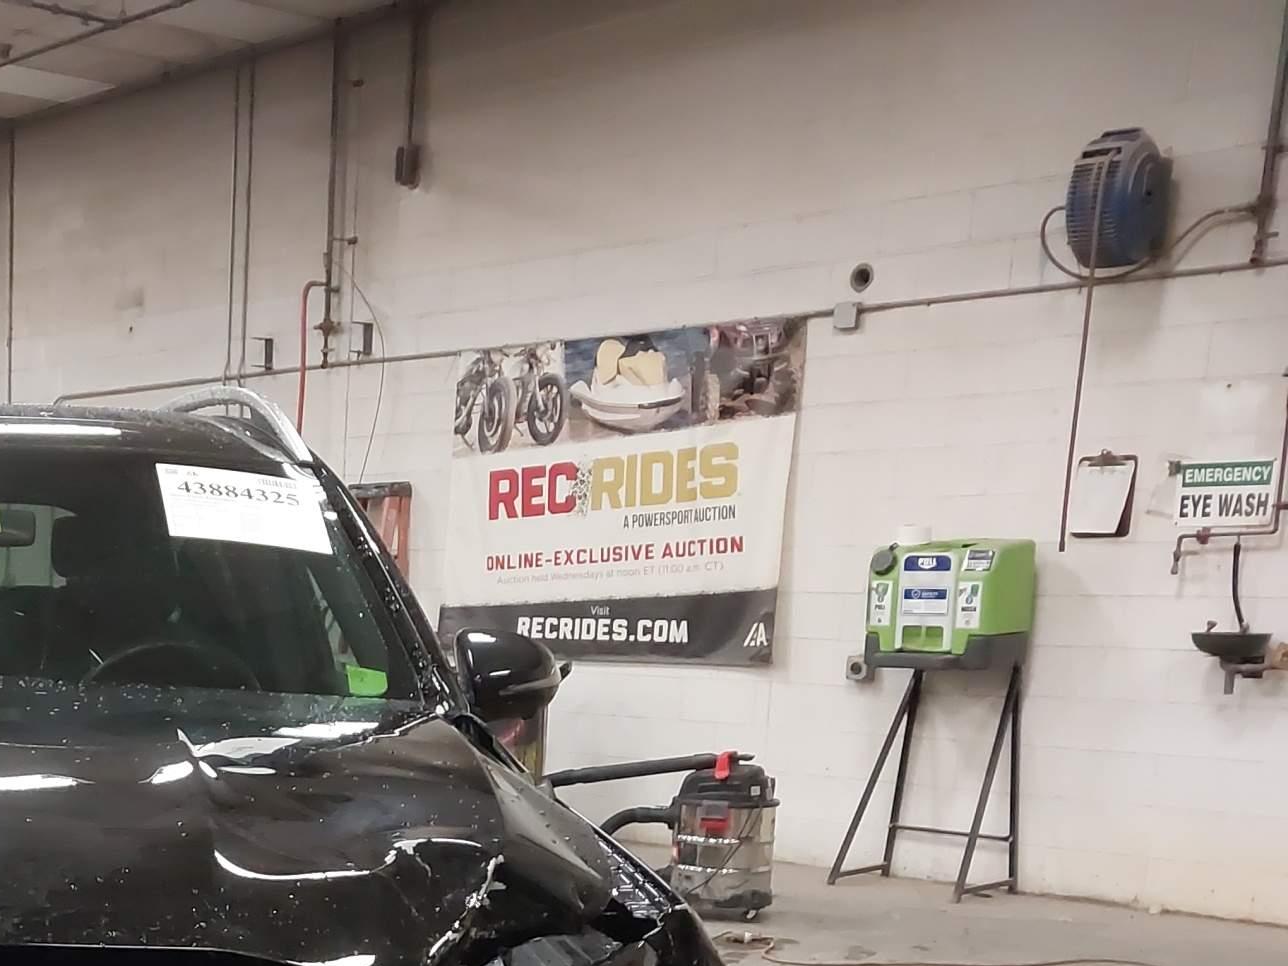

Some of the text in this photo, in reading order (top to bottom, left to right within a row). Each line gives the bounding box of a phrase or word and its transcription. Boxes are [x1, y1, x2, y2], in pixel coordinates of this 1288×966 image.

[489, 441, 740, 521] REC RIDES
[1184, 465, 1272, 483] EMERGENCY
[176, 480, 300, 506] 43884325
[1179, 493, 1270, 518] EYE WASH
[623, 514, 630, 529] A
[486, 536, 744, 571] ONLINE-EXCLUSIVE AUCTION
[590, 606, 610, 617] Visit
[516, 616, 689, 643] RECRIDES.COM
